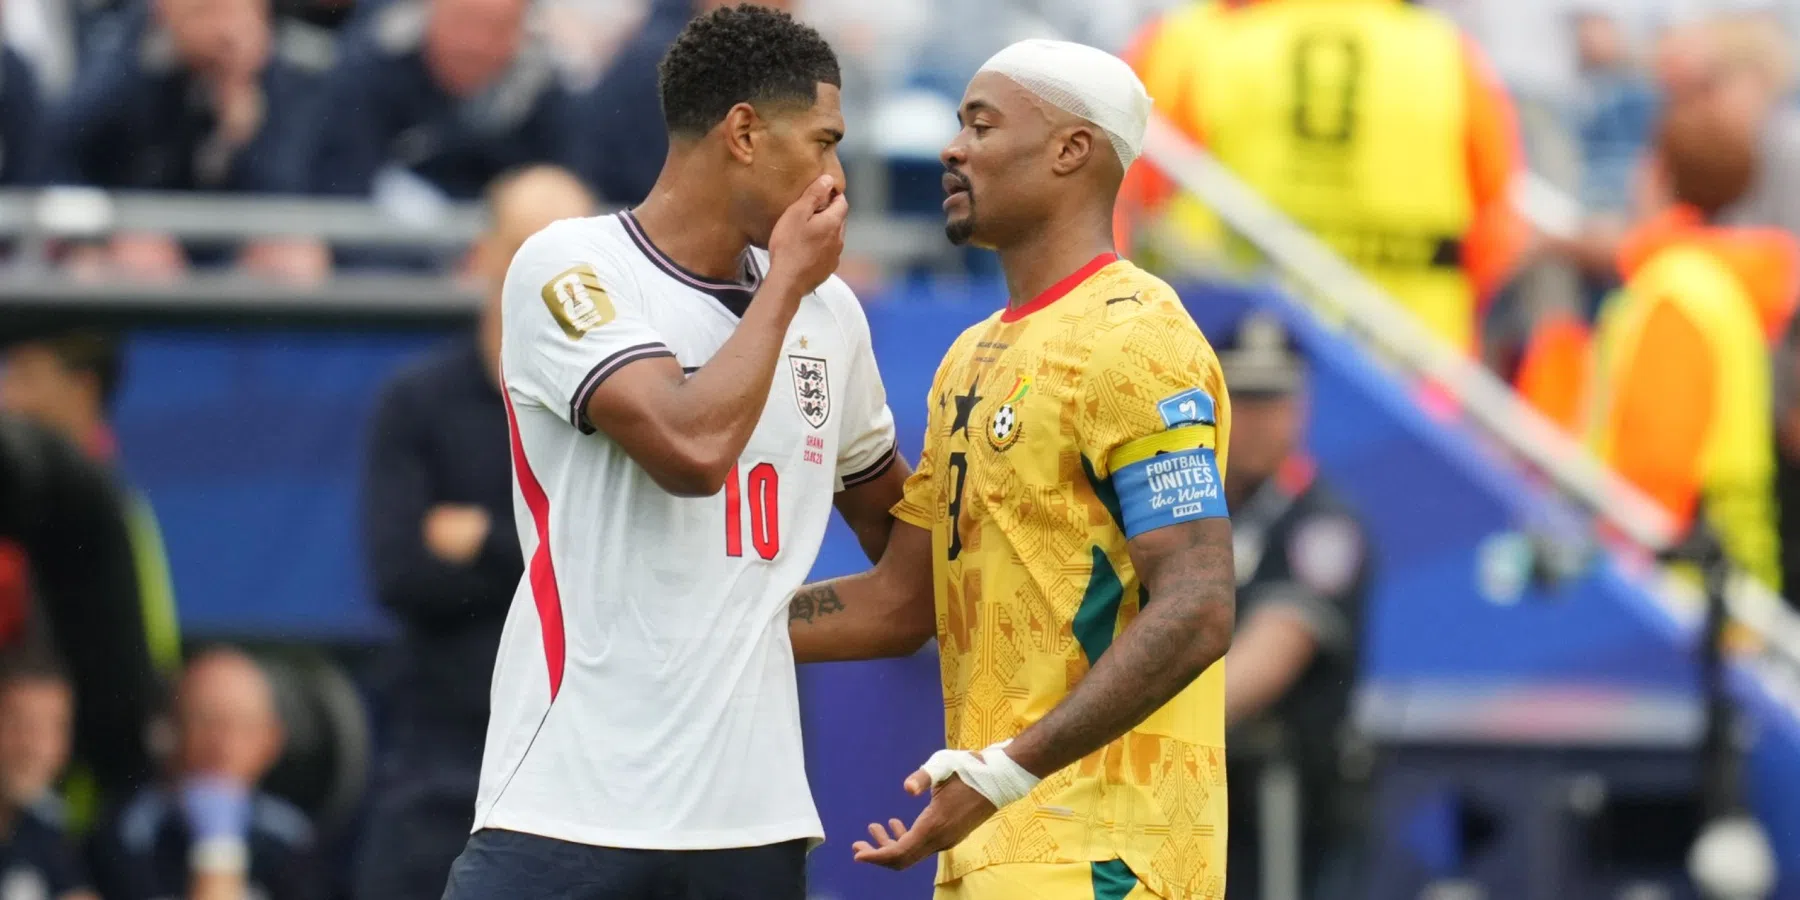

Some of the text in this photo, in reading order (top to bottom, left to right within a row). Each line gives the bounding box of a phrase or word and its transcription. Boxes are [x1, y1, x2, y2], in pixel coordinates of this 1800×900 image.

[806, 435, 823, 449] GHANA
[1146, 454, 1209, 476] FOOTBALL
[1148, 467, 1213, 493] UNITES
[947, 452, 968, 561] 9
[1149, 483, 1218, 510] the World
[1175, 503, 1200, 516] FIFA
[725, 460, 779, 561] 10
